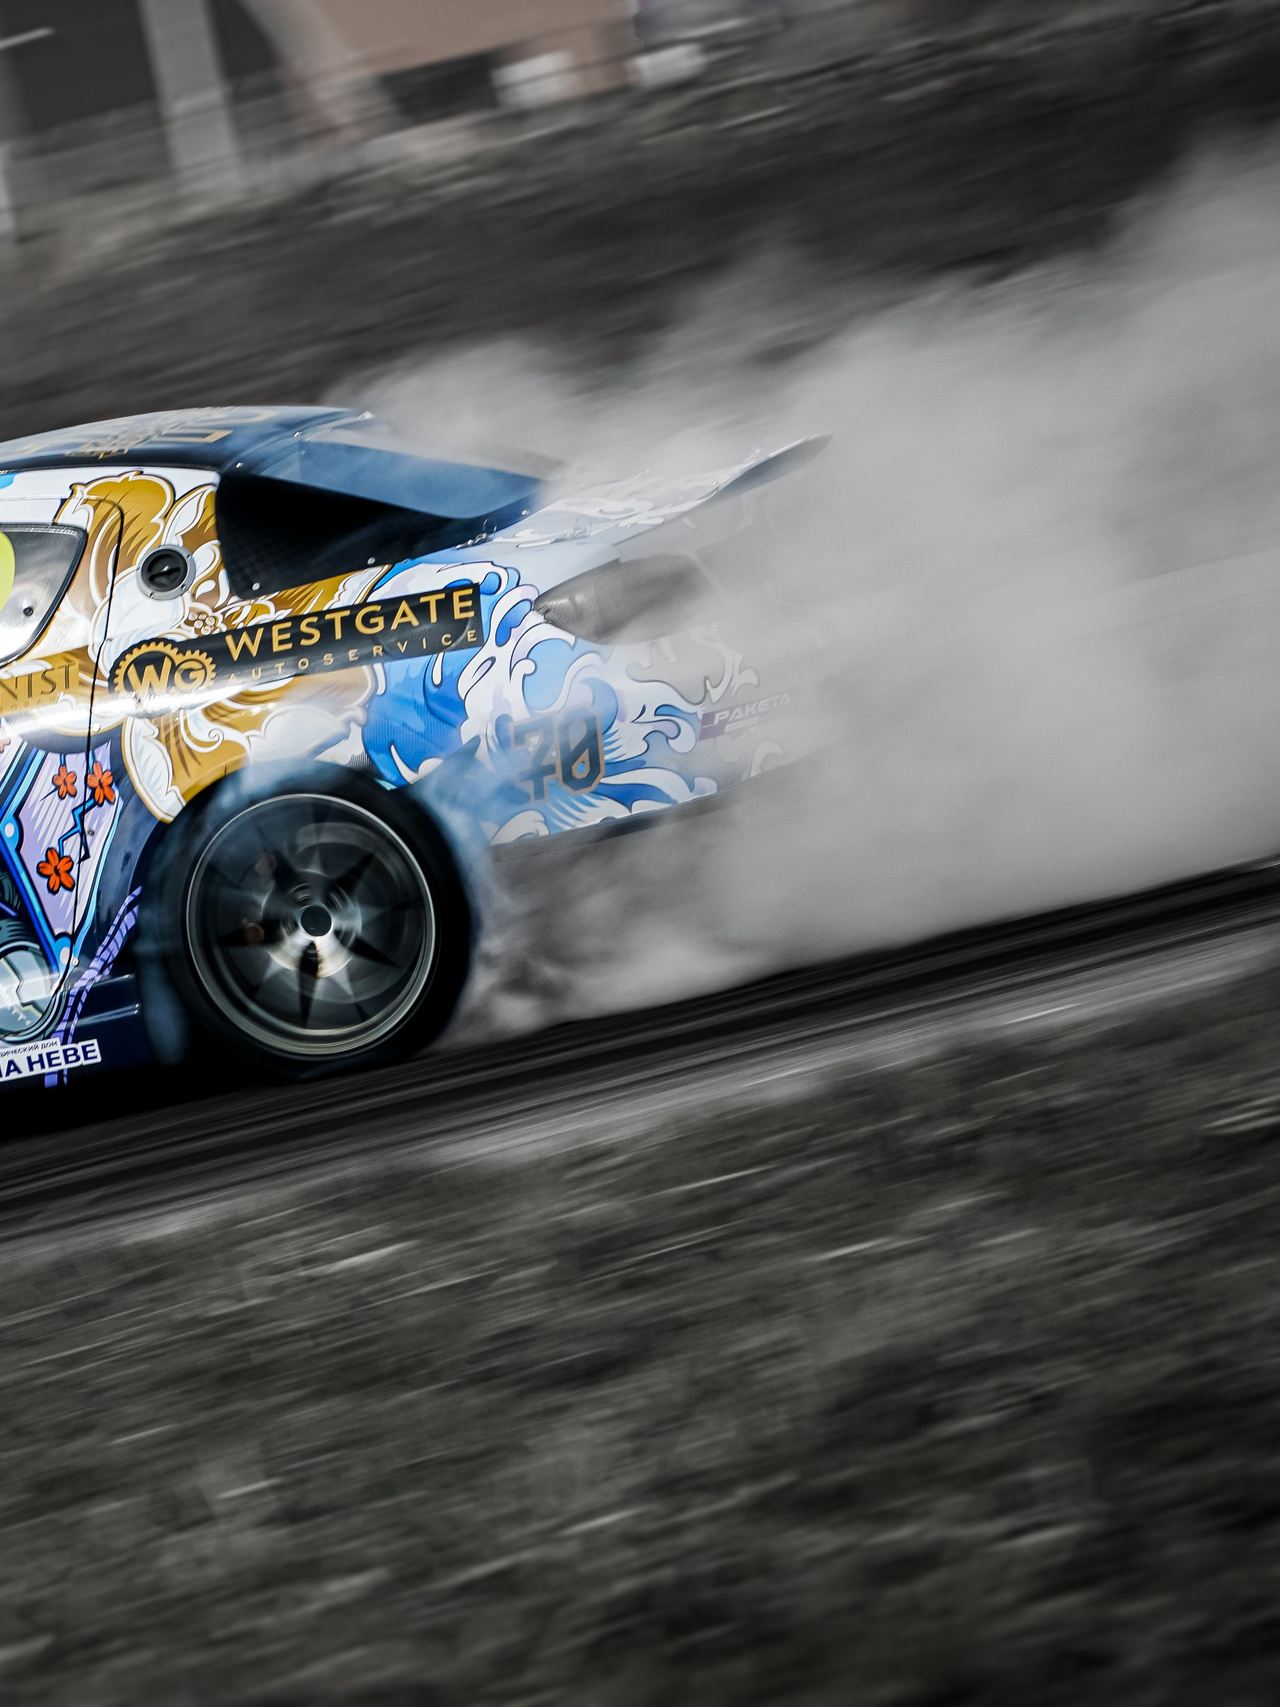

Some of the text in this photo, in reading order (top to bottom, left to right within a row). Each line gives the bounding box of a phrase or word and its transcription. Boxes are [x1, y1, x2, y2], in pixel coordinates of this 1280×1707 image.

[224, 588, 475, 662] WESTGATE
[127, 656, 206, 698] WG
[228, 629, 478, 687] AUTOSERVICE
[28, 1042, 99, 1071] НЕВЕ
